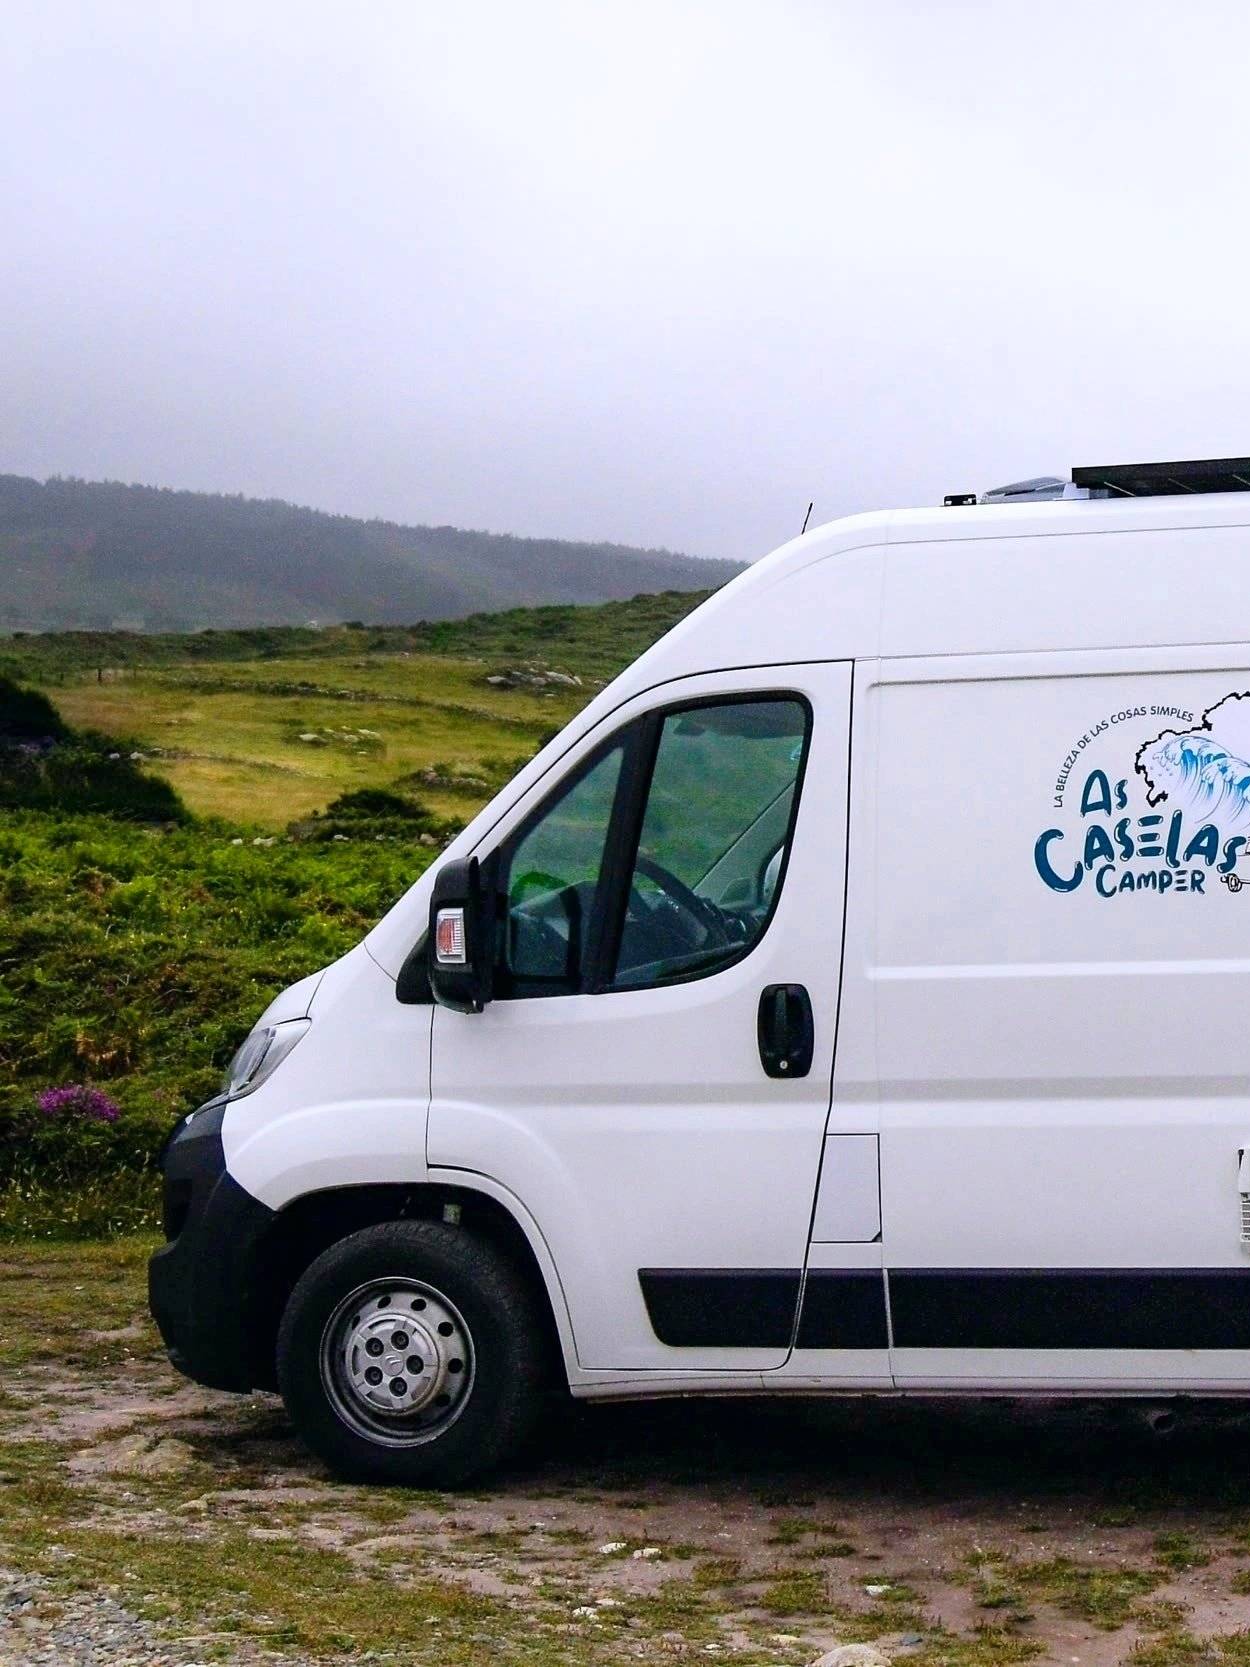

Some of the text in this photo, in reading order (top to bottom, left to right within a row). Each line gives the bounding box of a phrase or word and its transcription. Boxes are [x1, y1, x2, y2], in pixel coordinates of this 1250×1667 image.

[1054, 705, 1195, 808] LA BELLEZA DE LAS COSAS SIMPLES
[1095, 864, 1206, 898] CAMPER
